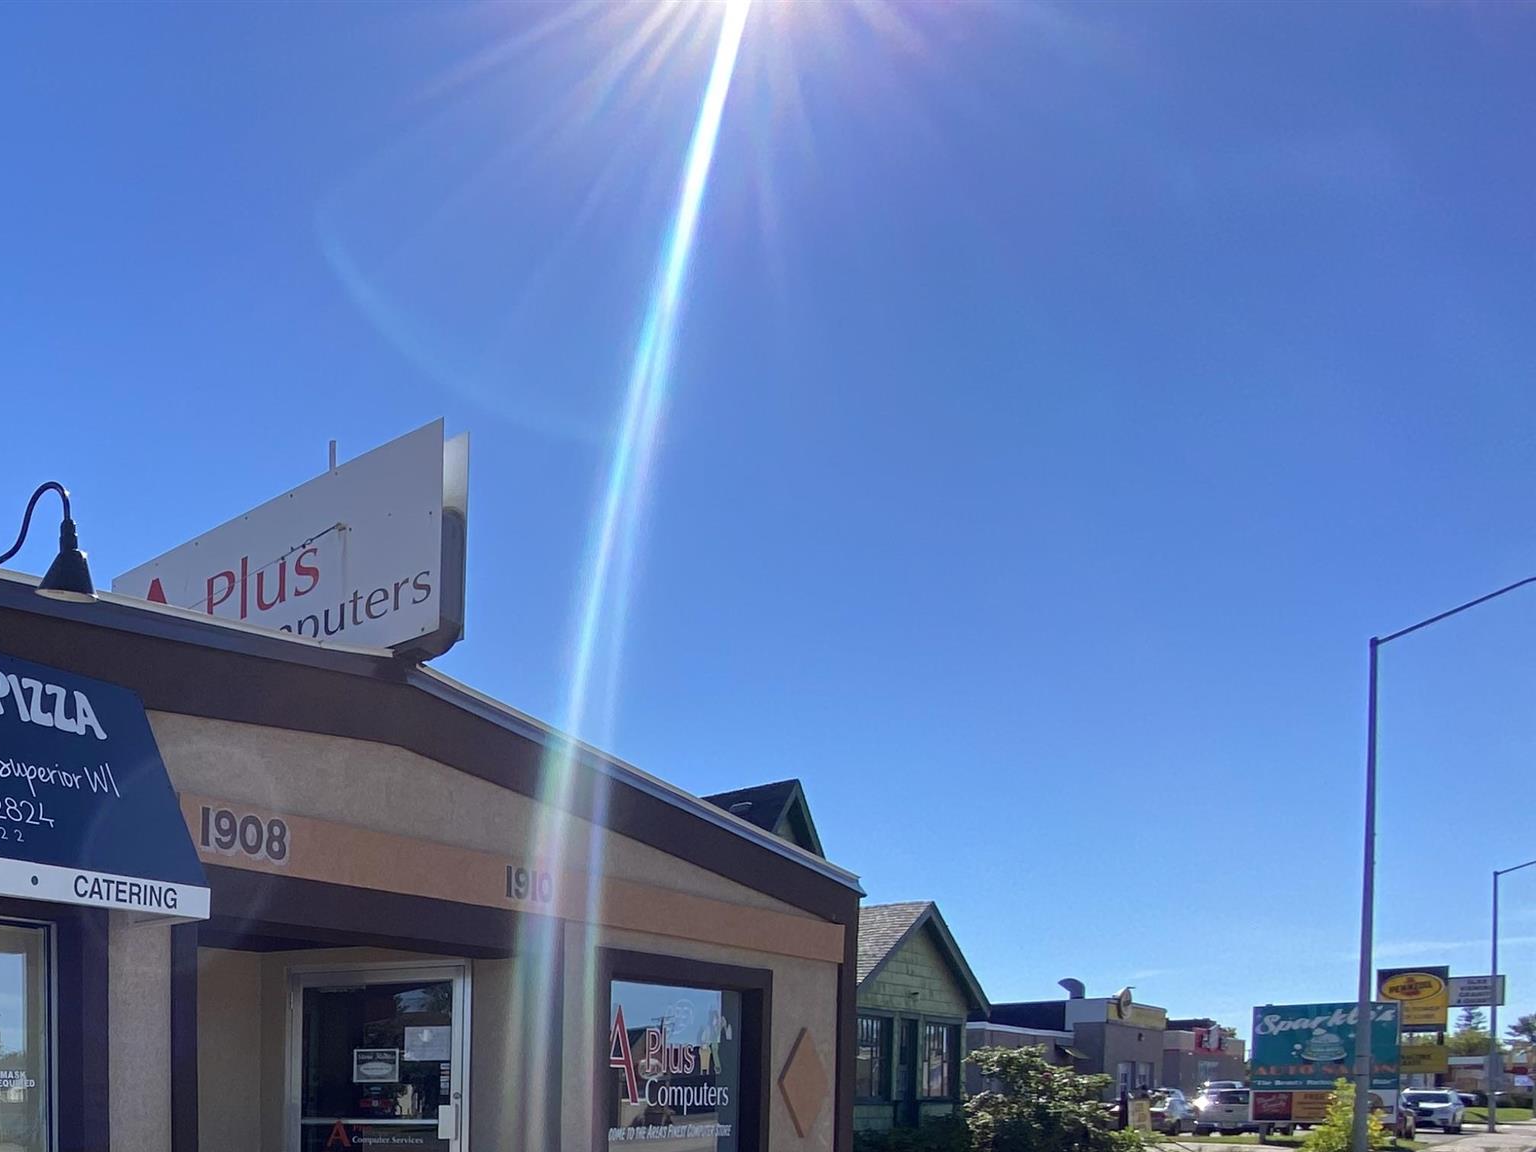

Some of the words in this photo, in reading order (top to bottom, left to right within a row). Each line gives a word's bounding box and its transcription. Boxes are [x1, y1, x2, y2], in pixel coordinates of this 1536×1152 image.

[207, 547, 320, 620] Plus
[279, 569, 433, 640] puters
[83, 762, 121, 798] WI
[199, 805, 289, 863] 1908
[73, 874, 178, 910] CATERING
[505, 864, 555, 903] 1910
[1256, 1006, 1396, 1036] Sparkl's
[610, 1005, 640, 1106] A
[644, 1027, 696, 1075] Plus
[0, 1070, 26, 1079] MASK
[644, 1078, 730, 1116] Computers
[326, 1120, 352, 1147] A
